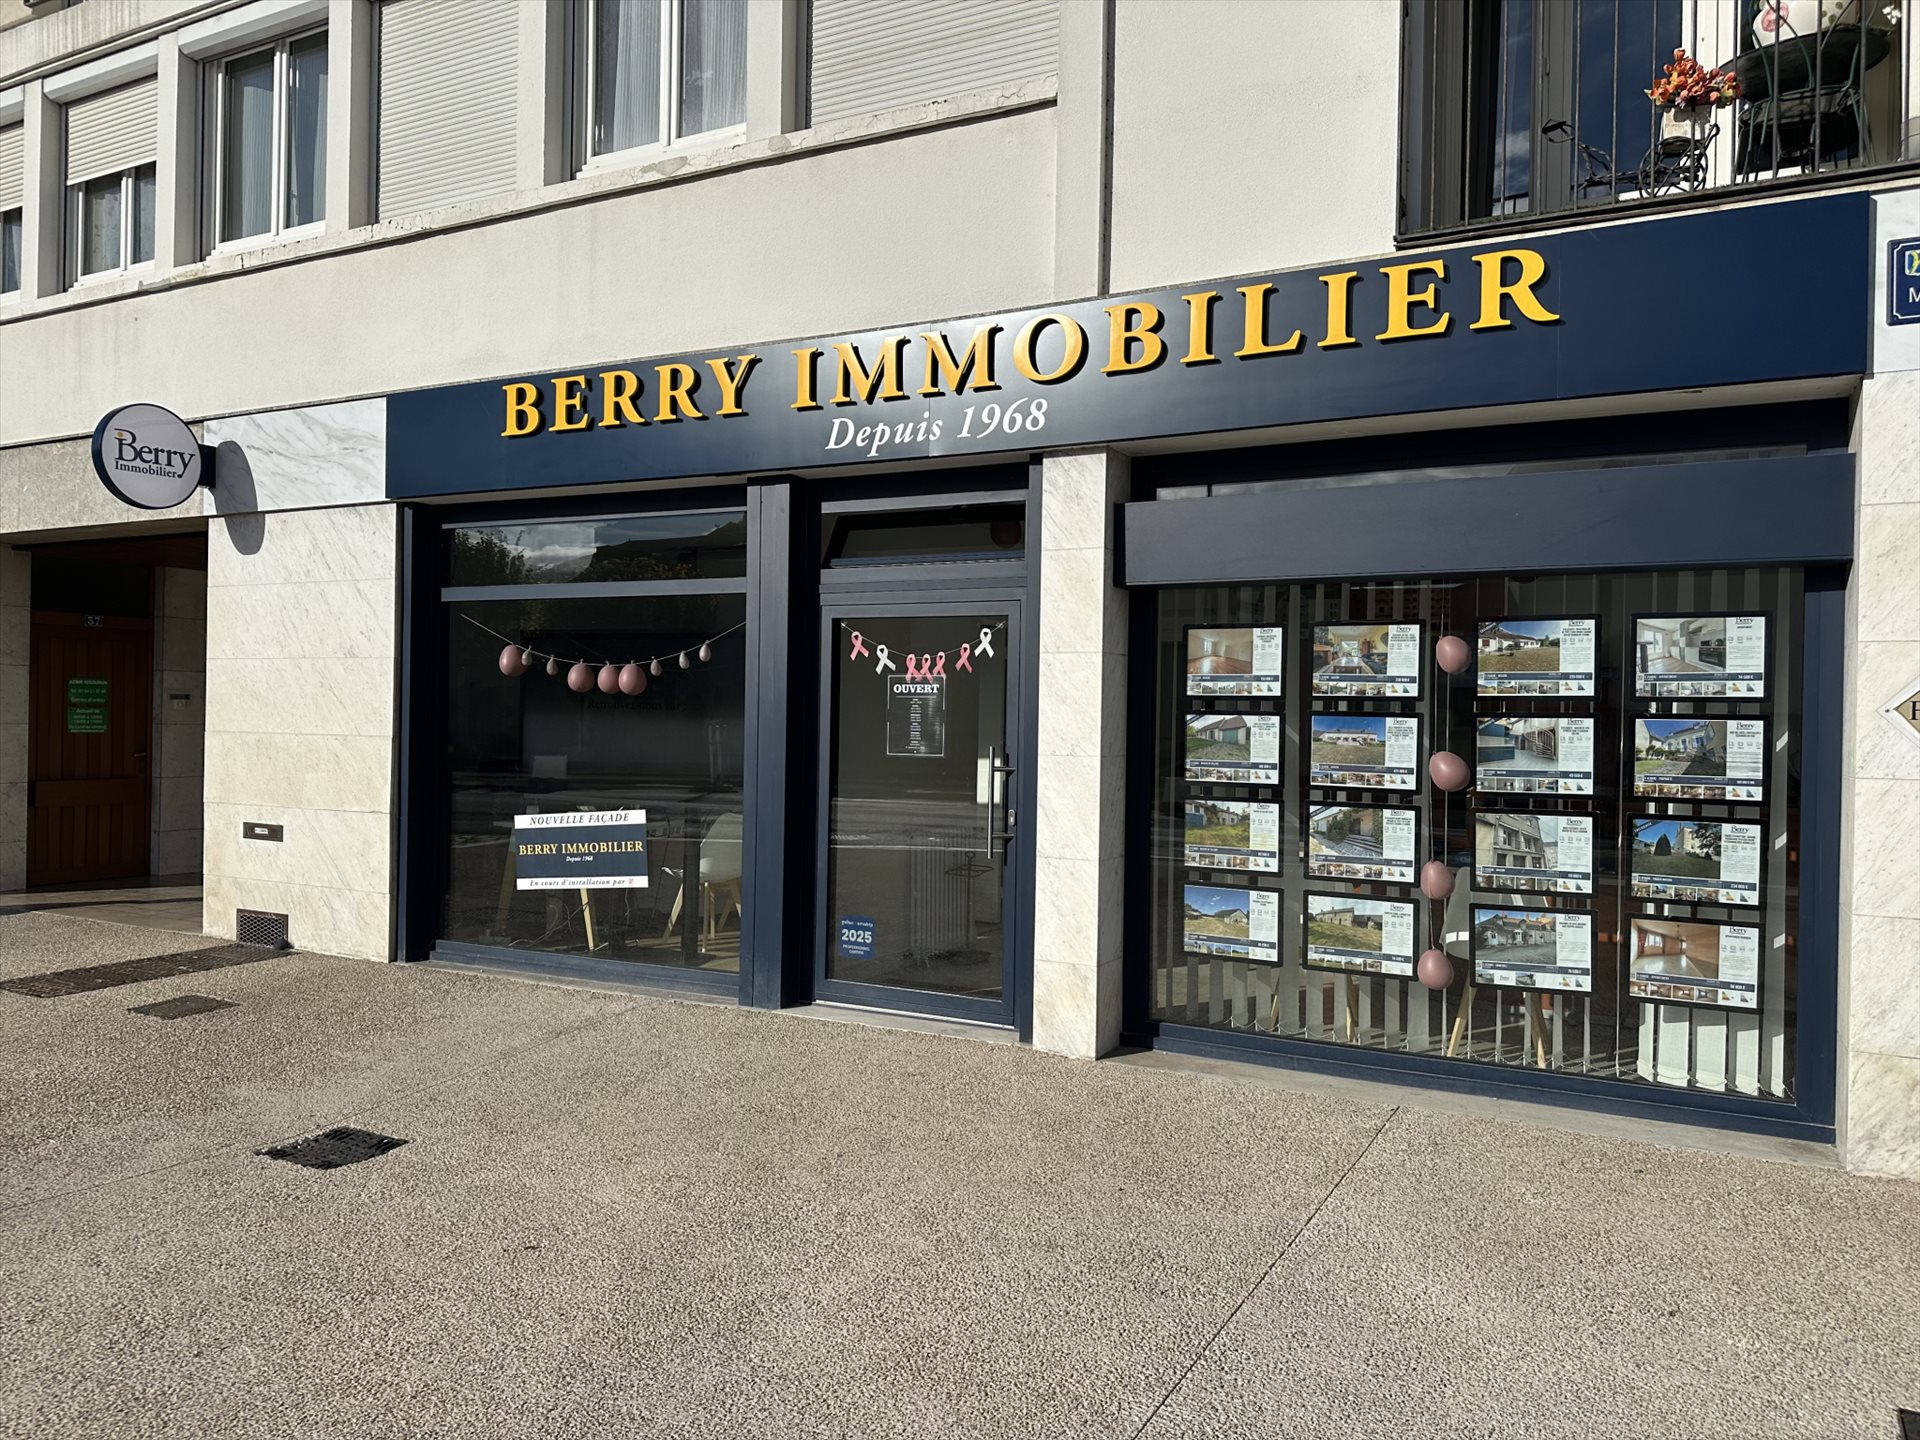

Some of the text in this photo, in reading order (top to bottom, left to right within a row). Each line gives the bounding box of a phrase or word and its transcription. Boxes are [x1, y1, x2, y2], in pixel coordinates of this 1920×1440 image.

[501, 249, 1561, 437] BERRY IMMOBILIER
[825, 397, 1048, 457] Depuis 1968
[114, 428, 195, 478] Berry
[114, 461, 177, 478] Immobilier
[893, 684, 940, 693] OUVERT
[529, 812, 630, 826] NOUVELLE FAÇADE
[519, 841, 643, 855] BERRY IMMOBILIER
[841, 928, 872, 943] 2025
